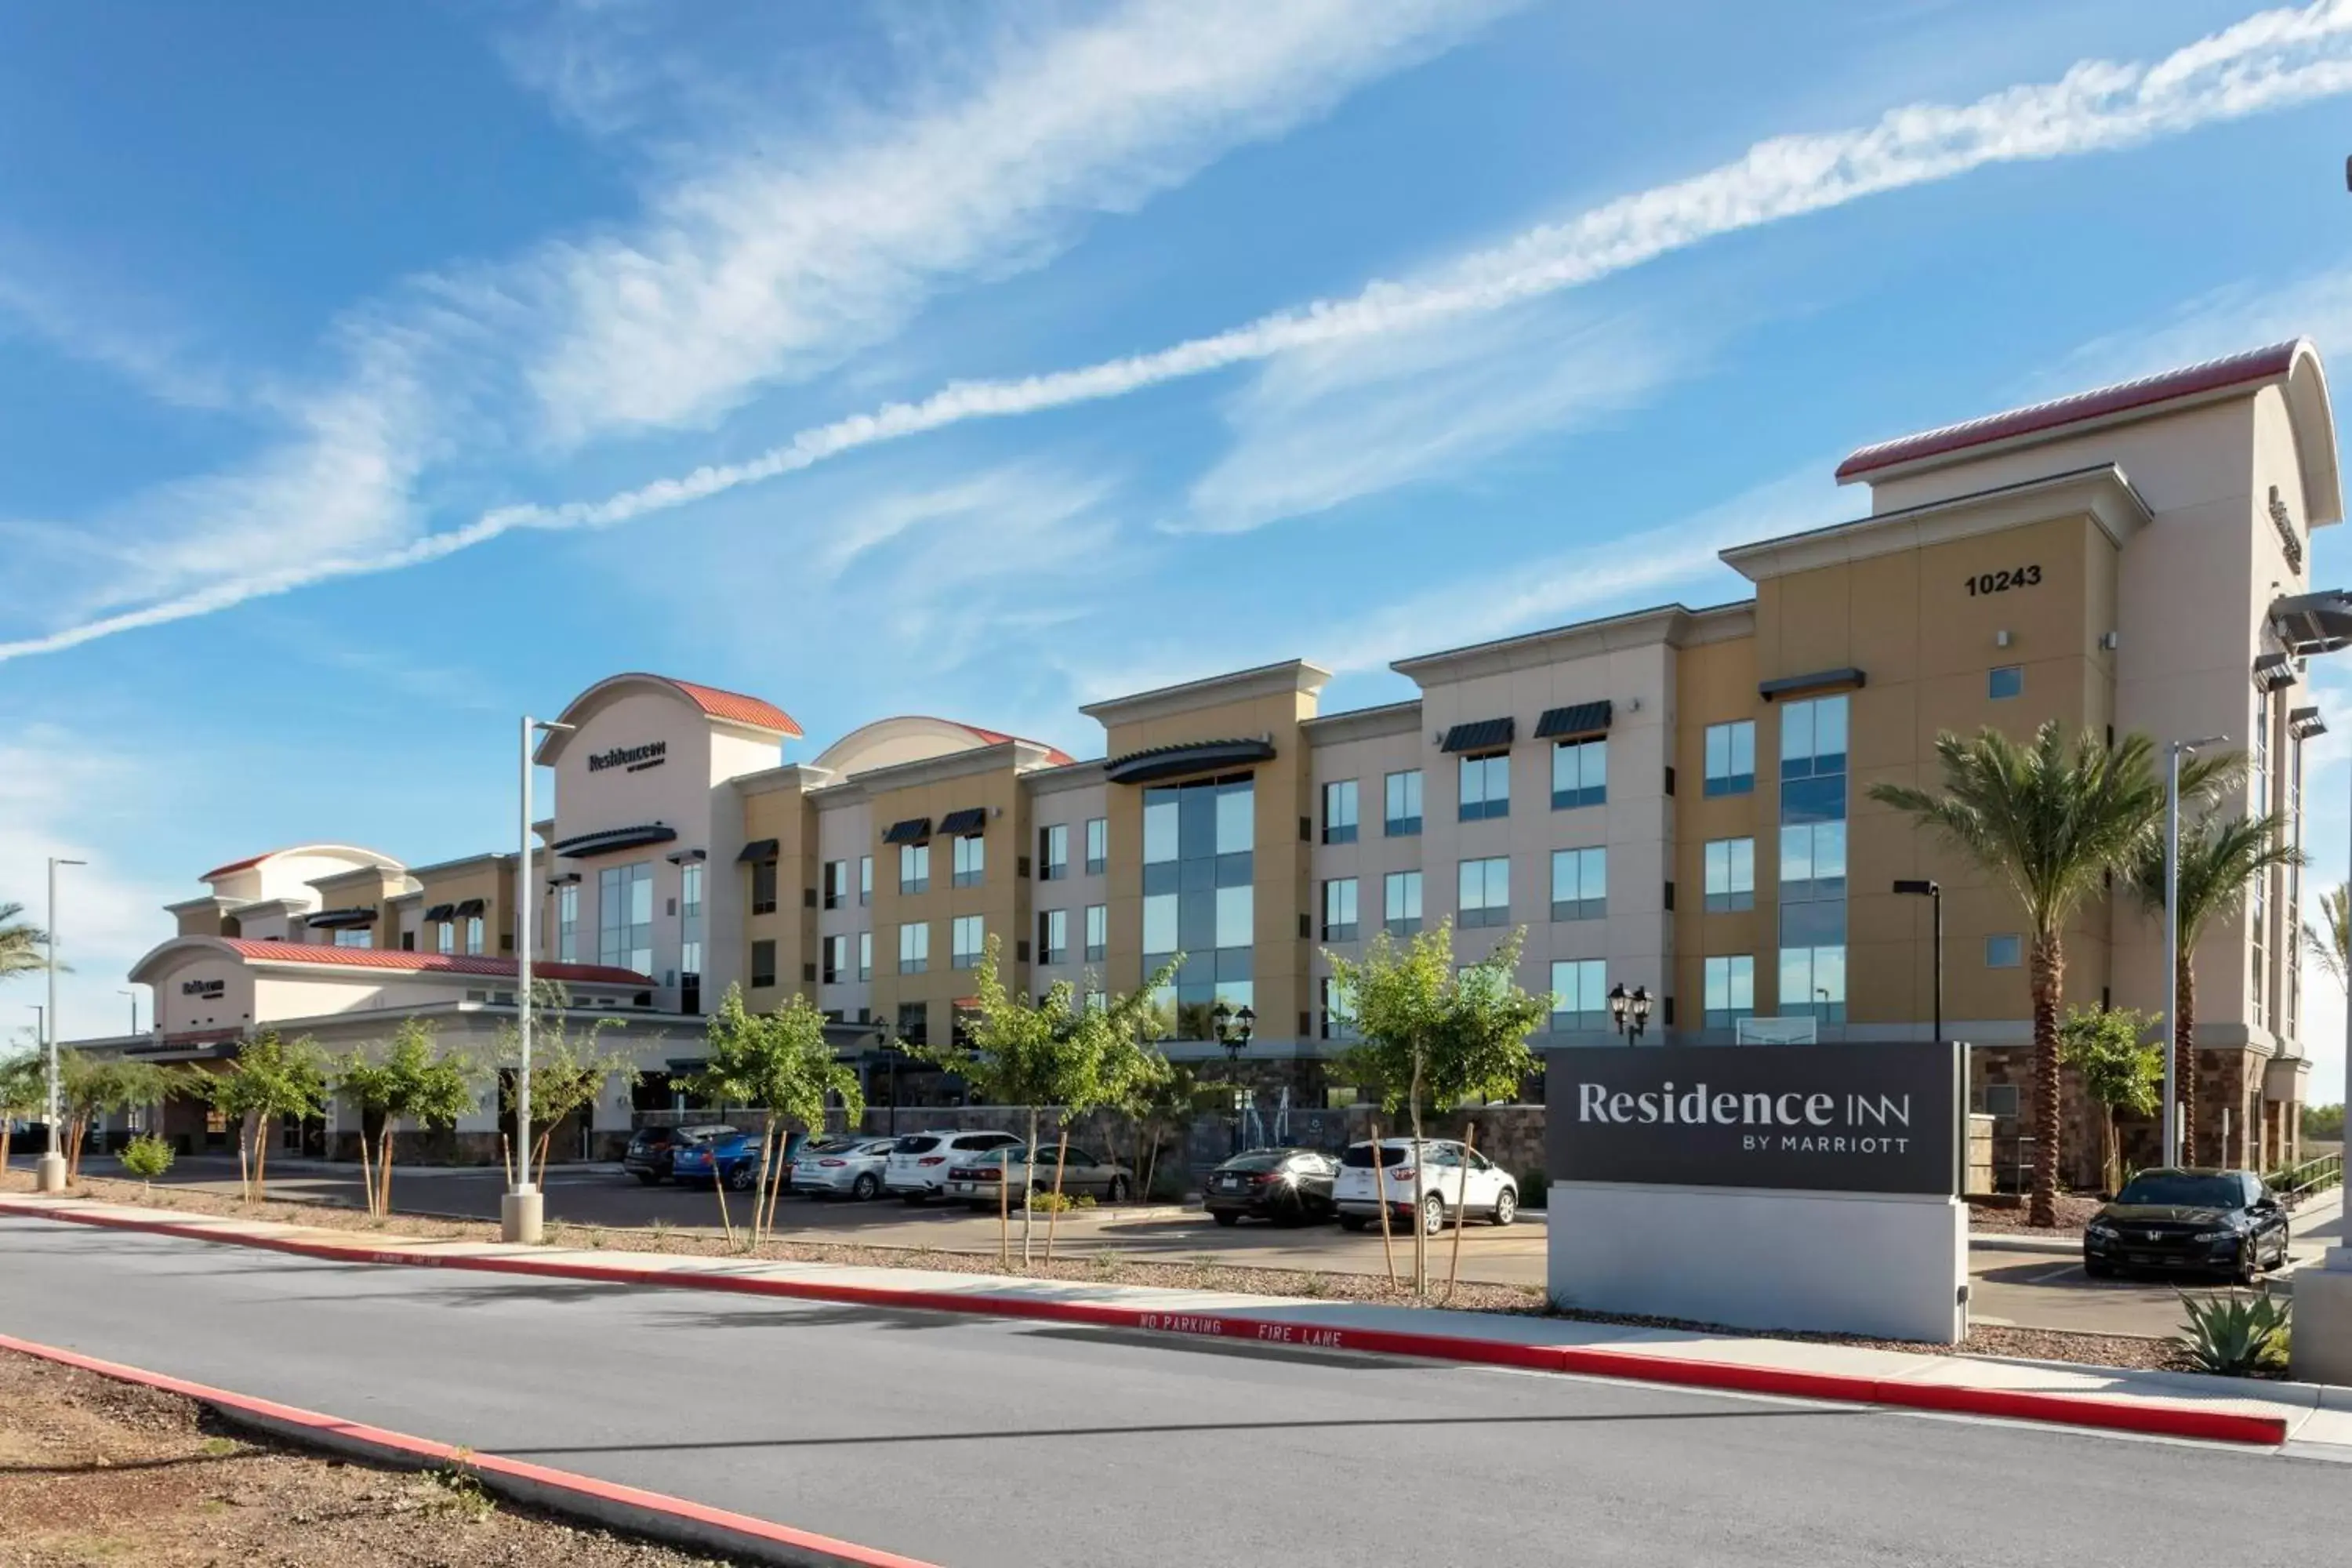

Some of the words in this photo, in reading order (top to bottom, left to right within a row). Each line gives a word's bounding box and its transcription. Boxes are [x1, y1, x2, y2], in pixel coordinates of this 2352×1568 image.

[1964, 564, 2042, 597] 10243
[1578, 1081, 1835, 1125] Residence
[1847, 1094, 1910, 1127] INN
[1743, 1135, 1770, 1151] BY
[1781, 1136, 1910, 1154] MARRIOTT
[1139, 1312, 1157, 1330] NO
[1163, 1315, 1222, 1333] PARKING
[1258, 1324, 1293, 1341] FIRE
[1301, 1329, 1343, 1348] LANE
